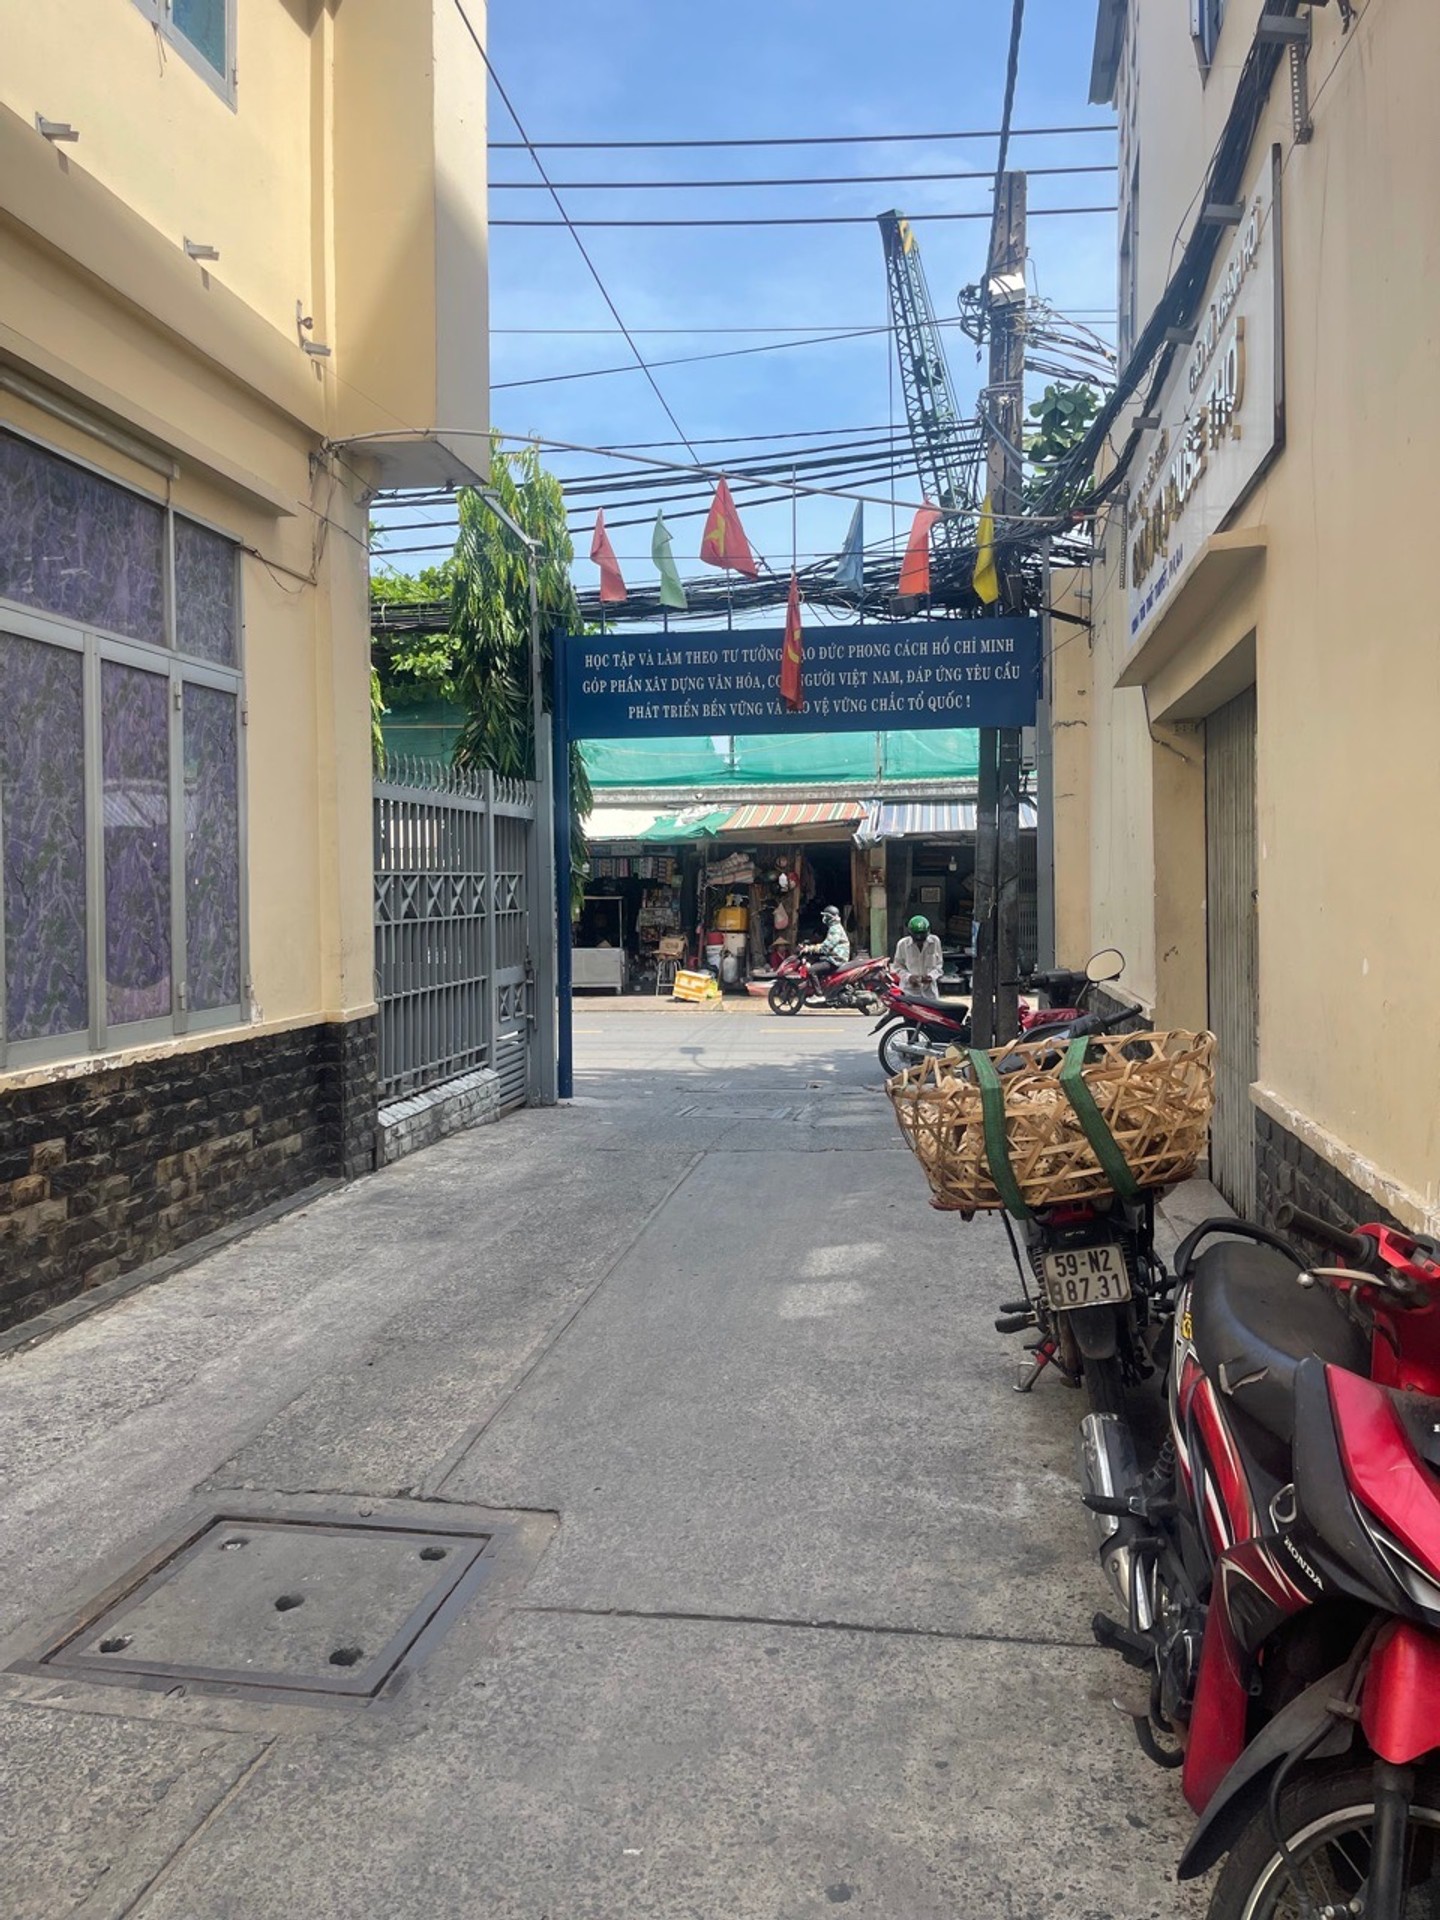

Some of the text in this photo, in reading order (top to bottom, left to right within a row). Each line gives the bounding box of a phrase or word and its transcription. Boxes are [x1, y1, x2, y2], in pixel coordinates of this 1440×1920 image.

[585, 654, 610, 671] HỌC
[612, 650, 636, 670] TẬP
[638, 648, 654, 666] VÀ
[657, 648, 682, 666] LÀM
[685, 650, 718, 665] THEO
[722, 648, 739, 663] TƯ
[741, 644, 783, 663] TƯỞNG
[819, 642, 845, 660] ĐỨC
[848, 643, 891, 658] PHONG
[894, 639, 928, 656] CÁCH
[953, 636, 976, 655] CHÍ
[980, 639, 1014, 653] MINH
[582, 676, 607, 694] GÓP
[644, 676, 667, 692] XÂY
[671, 676, 705, 694] DỰNG
[708, 674, 732, 690] VĂN
[736, 672, 765, 690] HÓA,
[839, 668, 868, 688] VIỆT
[872, 670, 903, 685] NAM,
[906, 665, 932, 683] ĐÁP
[935, 664, 962, 682] ỨNG
[965, 663, 991, 681] YÊU
[628, 701, 660, 719] PHÁT
[662, 698, 699, 718] TRIỂN
[729, 700, 763, 716] VỮNG
[766, 698, 782, 715] VÀ
[813, 697, 830, 716] VỆ
[833, 696, 867, 713] VỮNG
[871, 691, 905, 712] CHẮC
[907, 690, 924, 711] TỔ
[928, 690, 963, 712] QUỐC
[1054, 1249, 1112, 1277] 59-N2
[1284, 1535, 1324, 1591] HONDA
